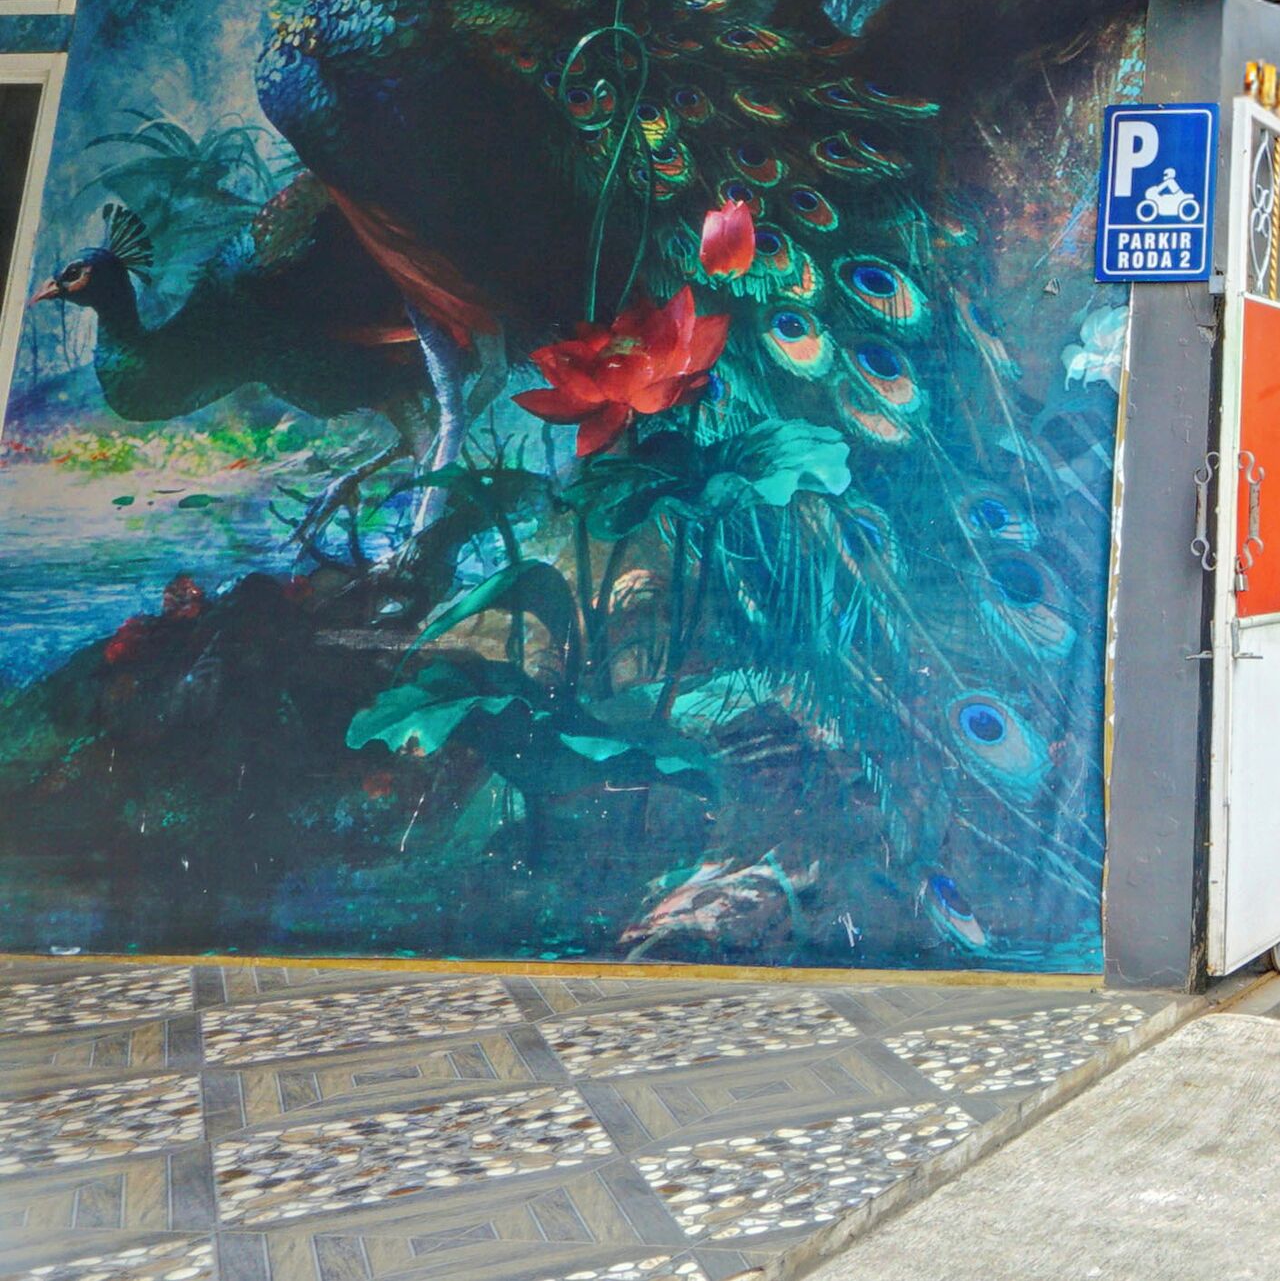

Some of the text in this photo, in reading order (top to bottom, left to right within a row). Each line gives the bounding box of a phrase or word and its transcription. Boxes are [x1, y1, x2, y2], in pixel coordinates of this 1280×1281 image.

[1113, 121, 1159, 198] P
[1117, 231, 1192, 250] PARKIR
[1117, 251, 1191, 268] RODA 2
